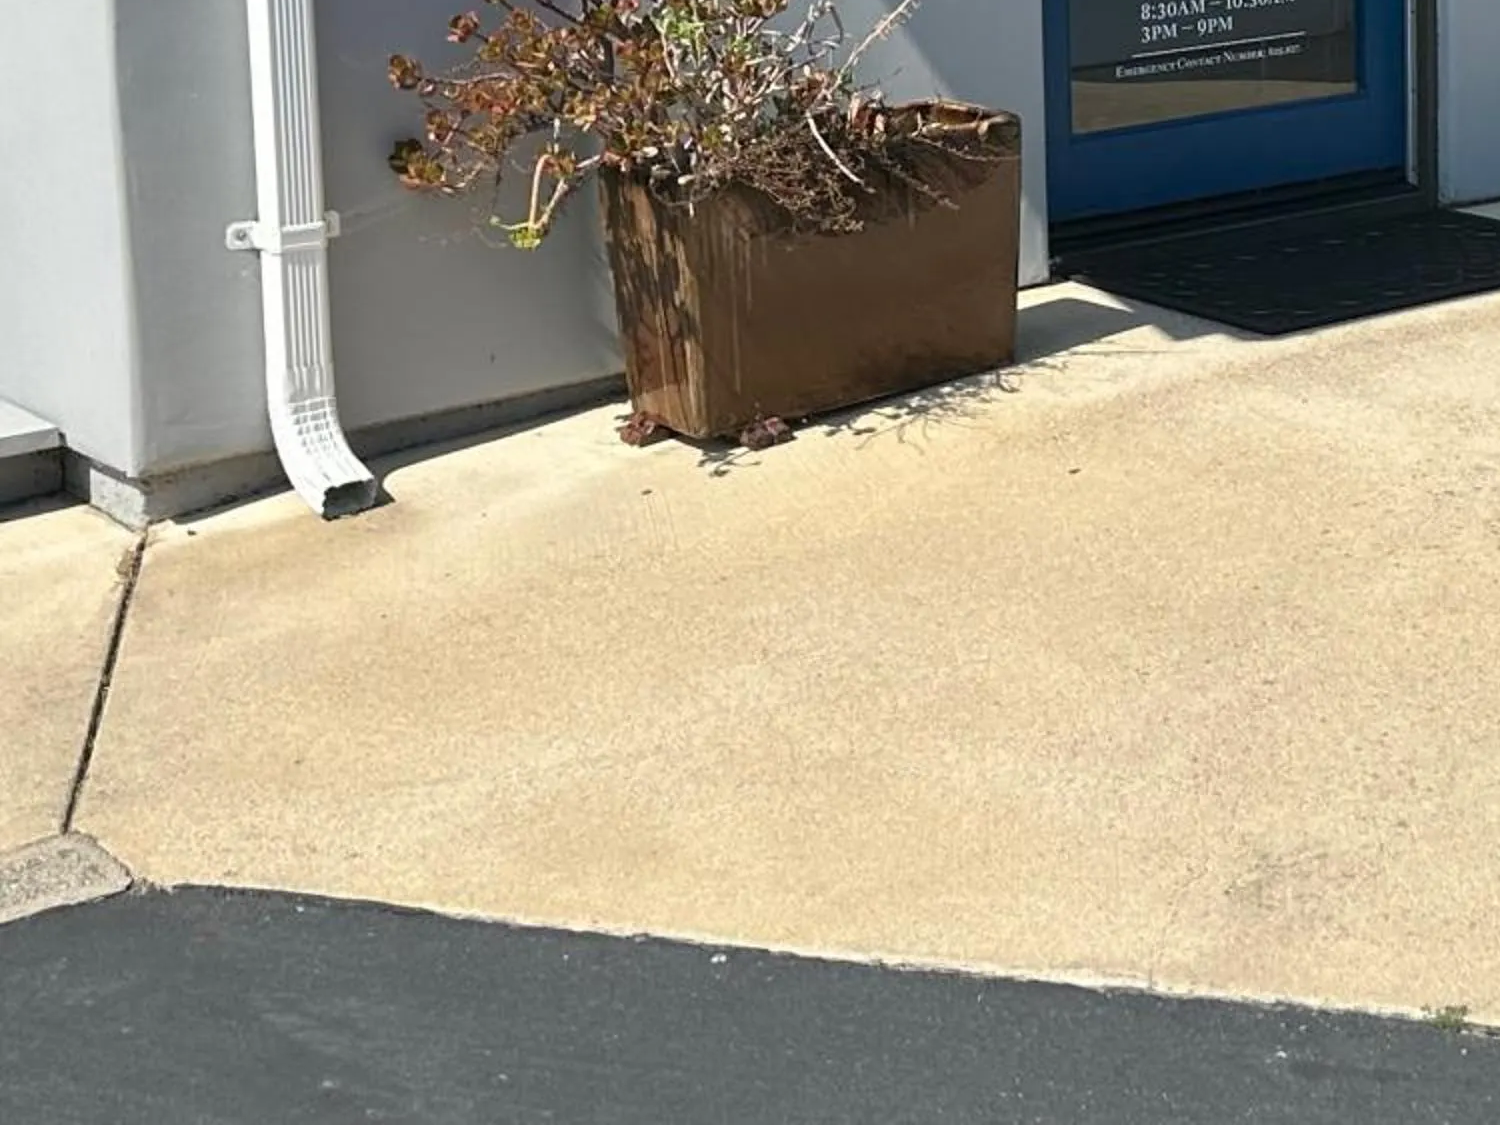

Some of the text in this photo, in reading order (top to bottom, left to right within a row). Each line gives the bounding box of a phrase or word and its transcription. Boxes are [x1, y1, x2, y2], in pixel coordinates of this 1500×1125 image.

[1140, 23, 1178, 44] 3PM
[1197, 15, 1233, 36] 9PM
[1177, 54, 1221, 70] CONTACT
